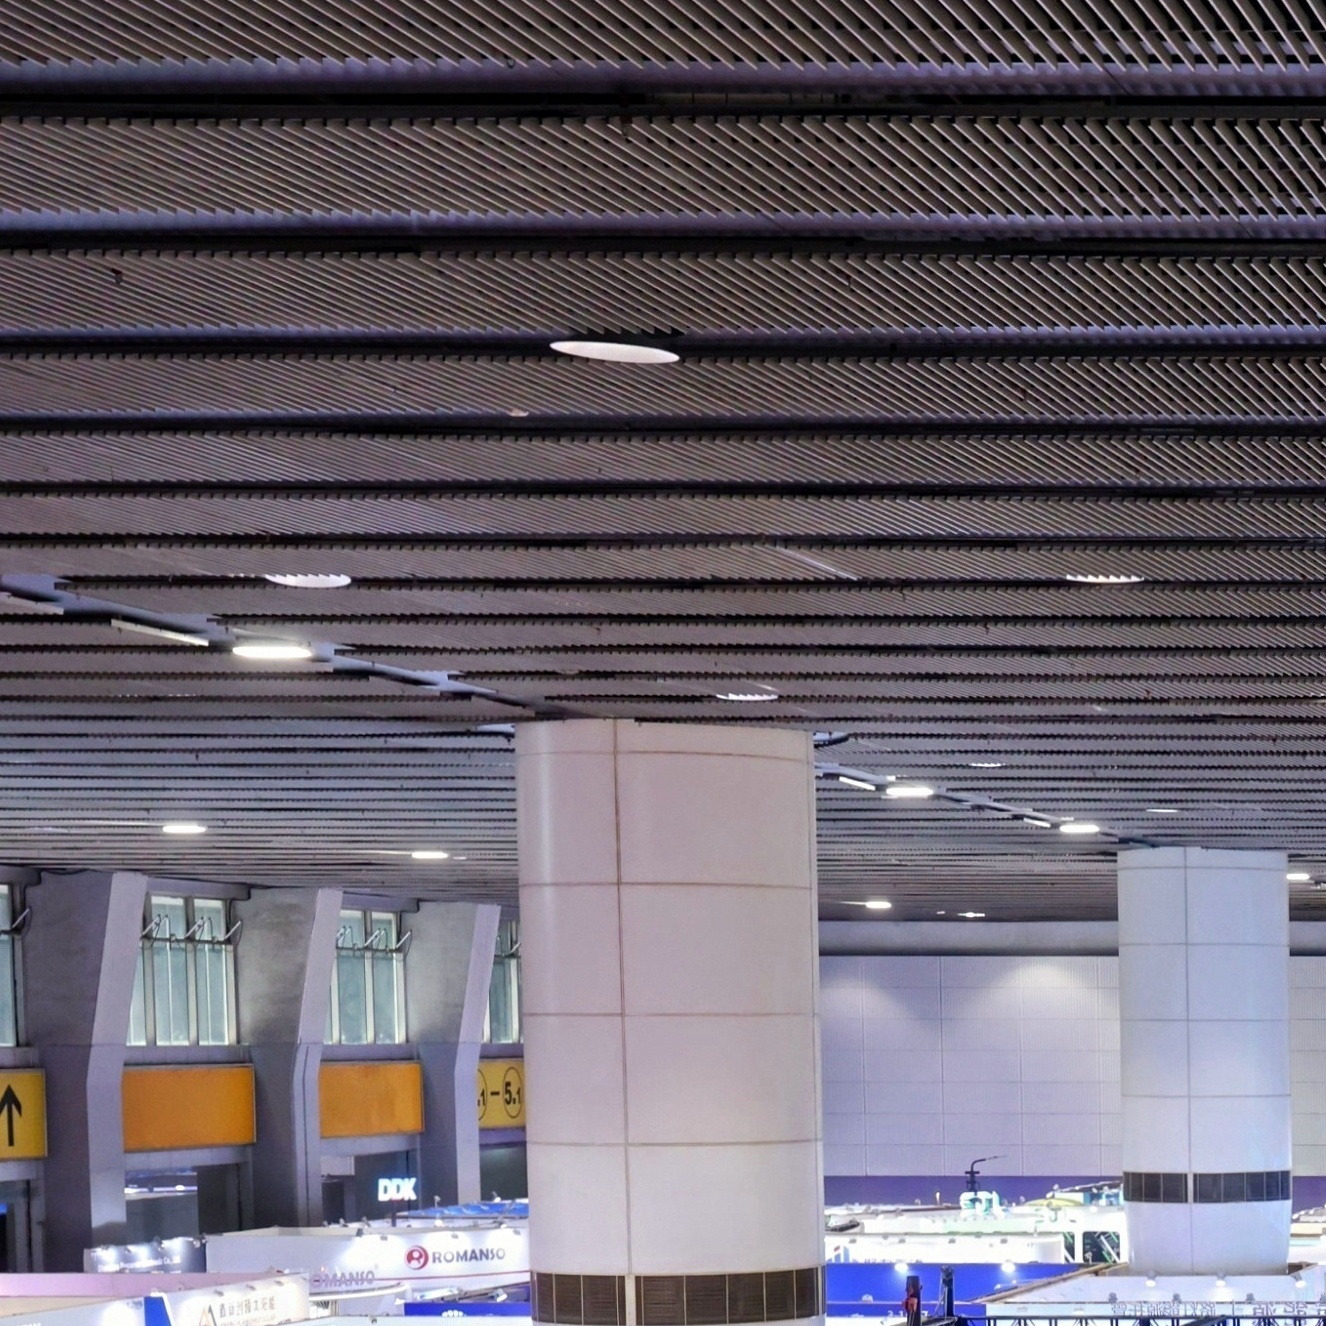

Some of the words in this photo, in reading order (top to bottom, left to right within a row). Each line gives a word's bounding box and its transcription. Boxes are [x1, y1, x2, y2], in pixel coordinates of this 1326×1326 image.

[378, 1178, 417, 1201] DDK
[432, 1248, 505, 1263] ROMANSO
[312, 1270, 375, 1288] OMANSO
